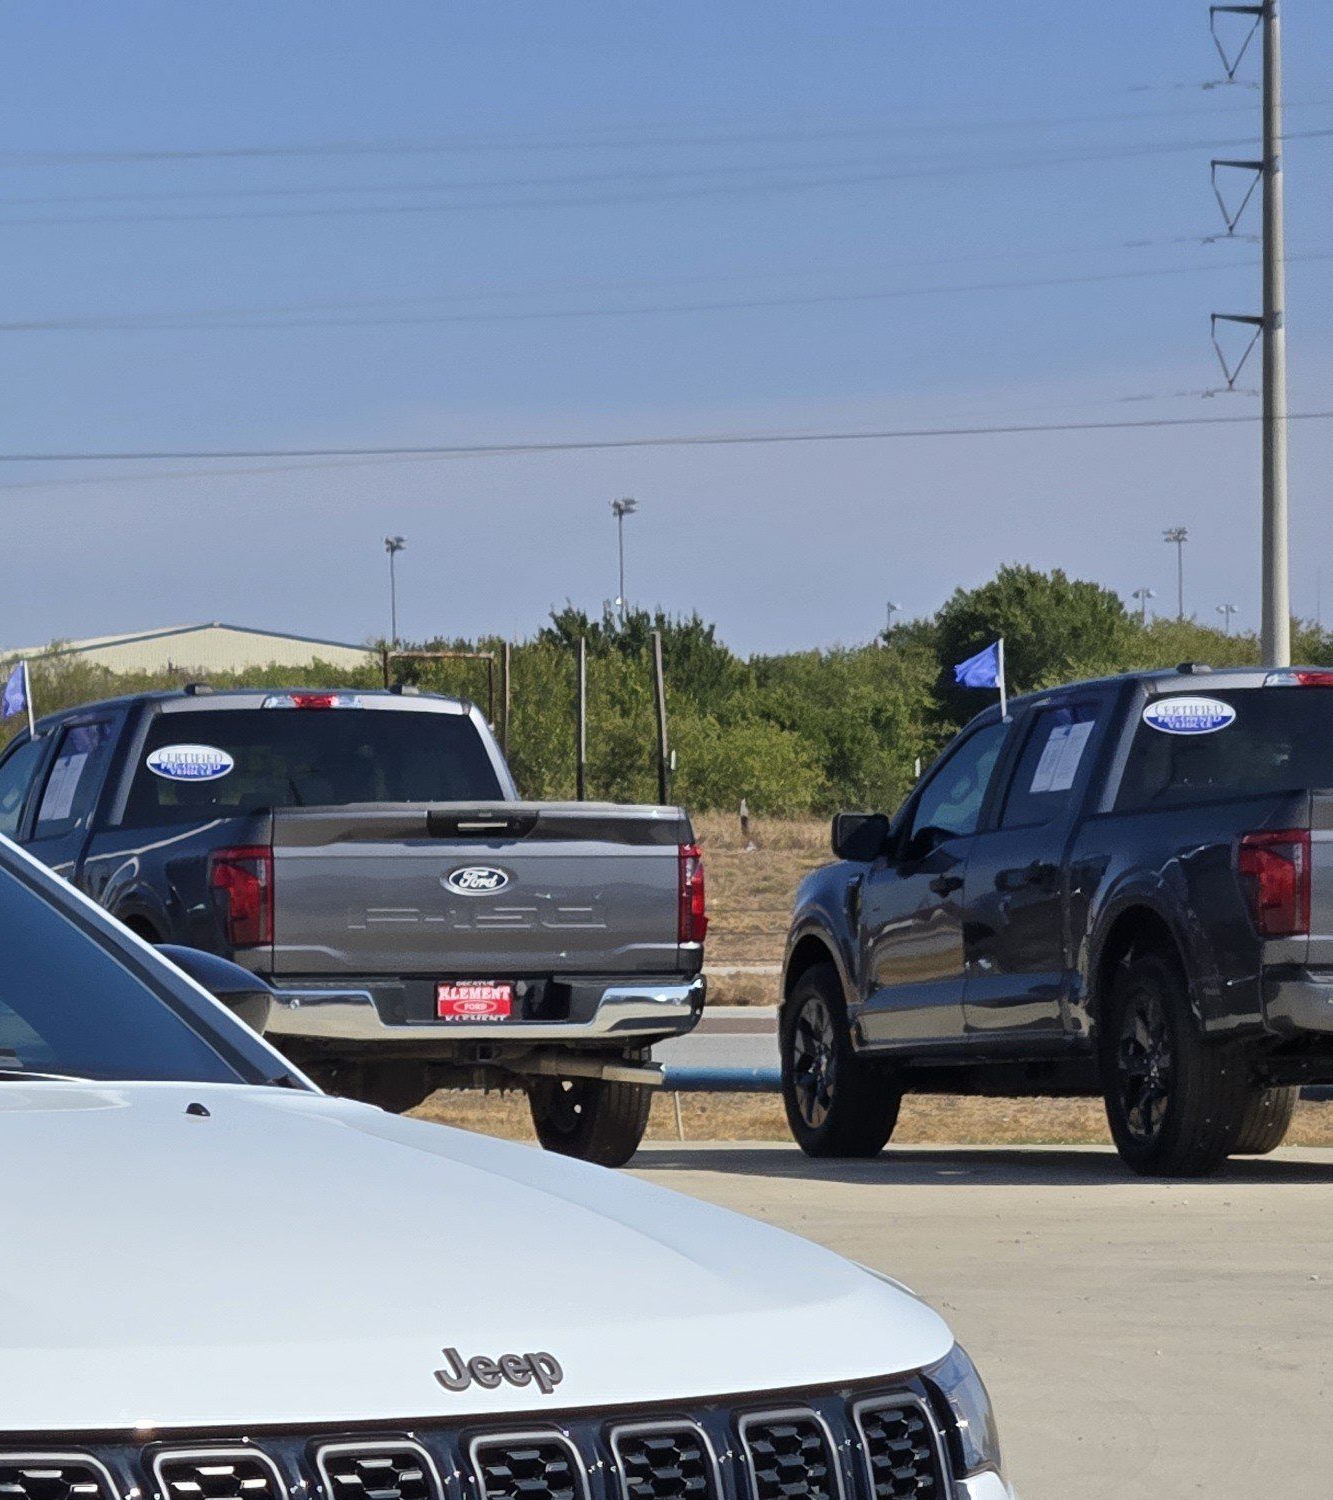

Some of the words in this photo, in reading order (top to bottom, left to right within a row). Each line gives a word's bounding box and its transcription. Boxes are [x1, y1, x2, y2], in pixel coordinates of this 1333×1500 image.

[459, 871, 498, 887] Ford
[438, 986, 511, 1000] KLEMENT
[434, 1347, 563, 1394] Jeep
